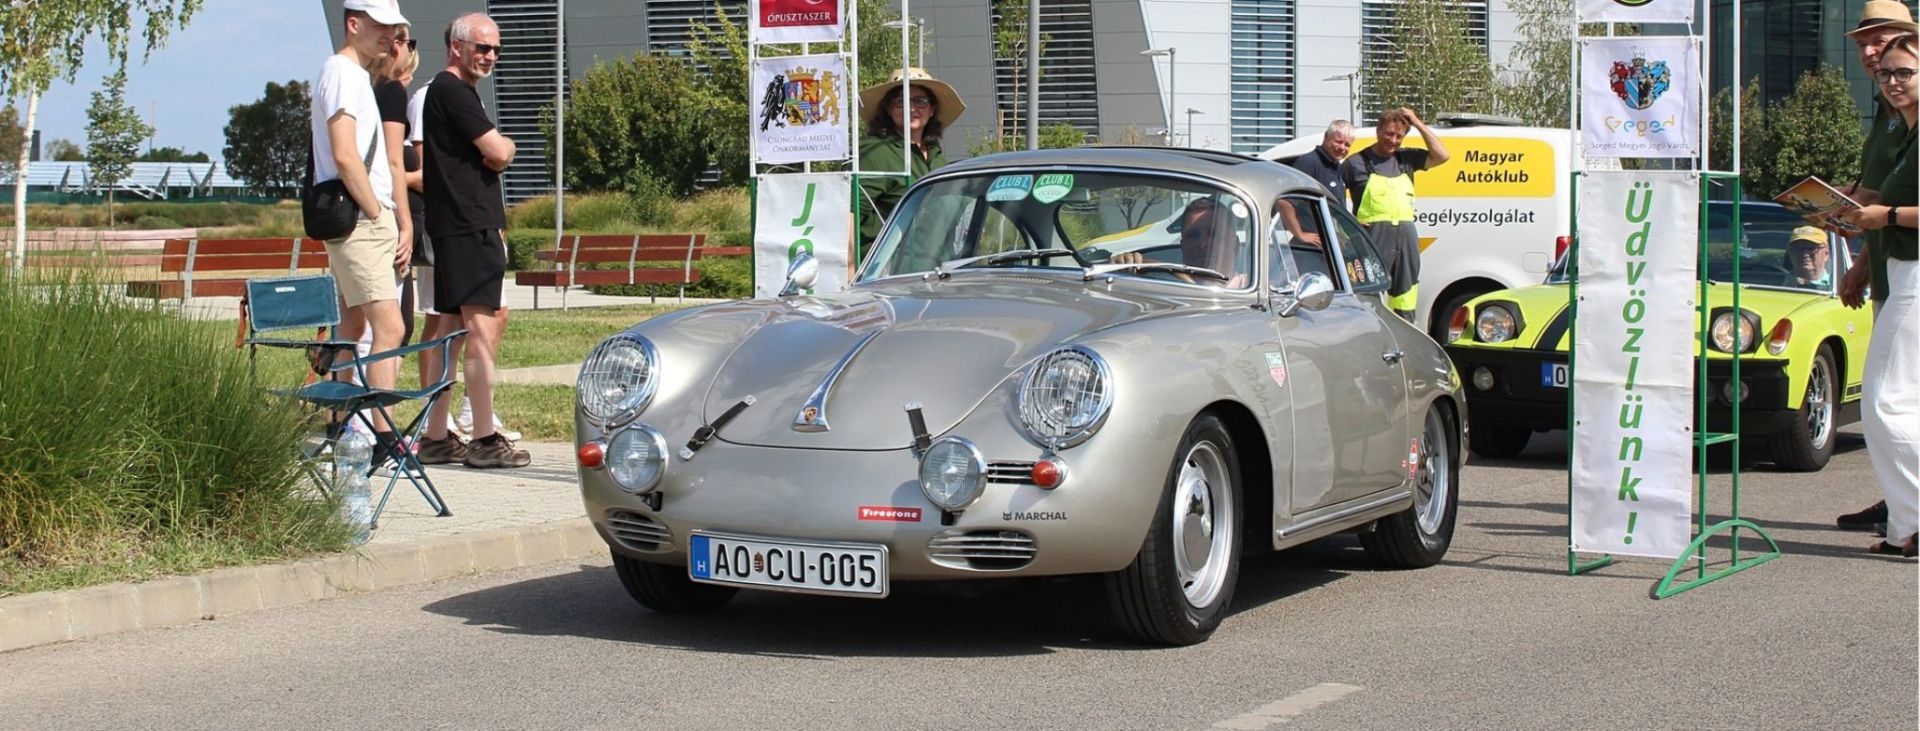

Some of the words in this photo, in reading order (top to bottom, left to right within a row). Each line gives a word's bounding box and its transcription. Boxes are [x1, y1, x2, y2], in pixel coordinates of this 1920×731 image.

[767, 12, 831, 22] ÓPUSZTASZER
[1465, 150, 1524, 165] Magyar
[1040, 175, 1064, 185] CLUB
[1456, 170, 1529, 183] Autóklub
[996, 177, 1021, 188] CLUB
[1618, 181, 1653, 545] Üdvözlünk!
[862, 508, 918, 519] Firestone
[1014, 511, 1068, 521] MARCHAL
[697, 560, 706, 572] H
[766, 548, 877, 588] CU-005
